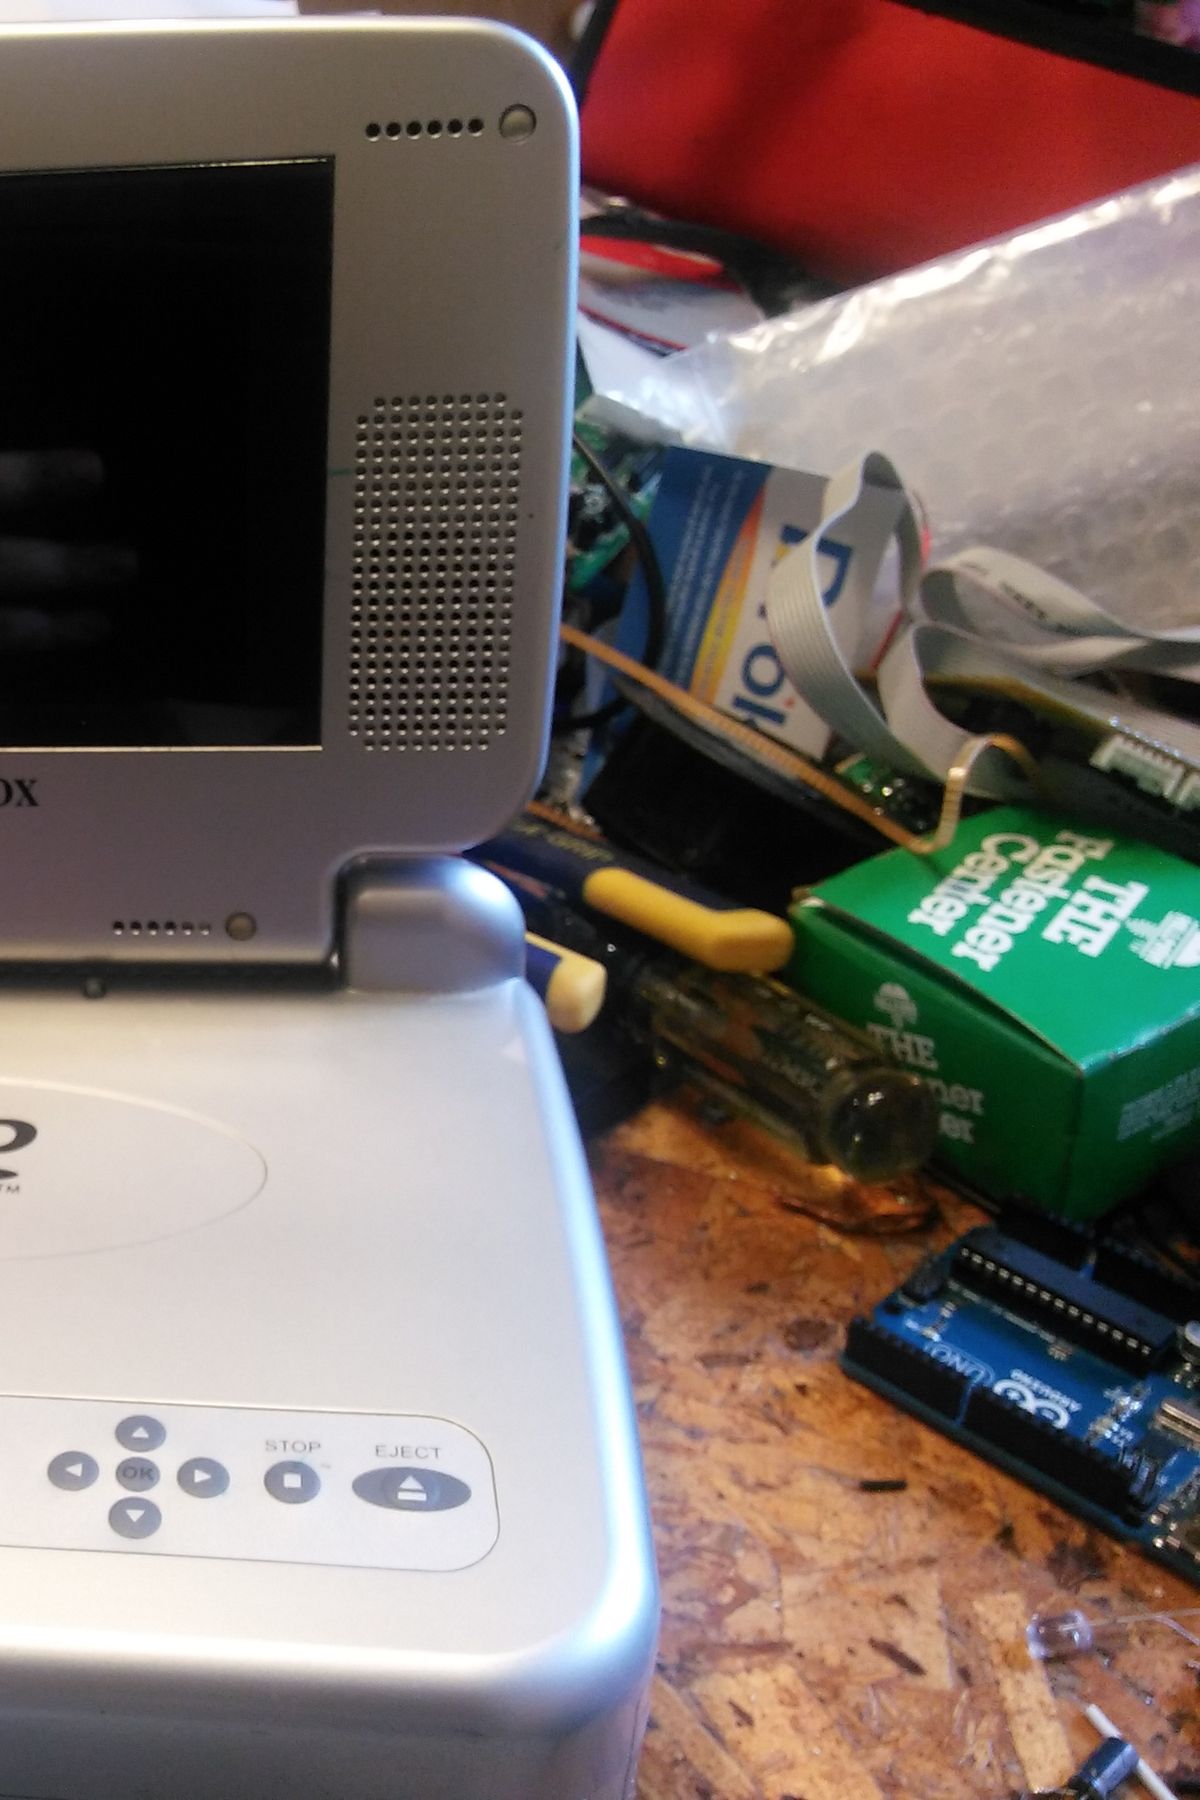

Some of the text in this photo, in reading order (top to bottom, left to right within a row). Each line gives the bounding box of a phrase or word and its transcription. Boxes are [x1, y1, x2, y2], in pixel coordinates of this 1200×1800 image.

[907, 832, 1040, 936] Center
[952, 829, 1115, 973] Fastener
[1041, 875, 1149, 958] THE
[264, 1439, 323, 1455] STOP
[375, 1444, 442, 1460] EJECT
[121, 1465, 155, 1482] OK
